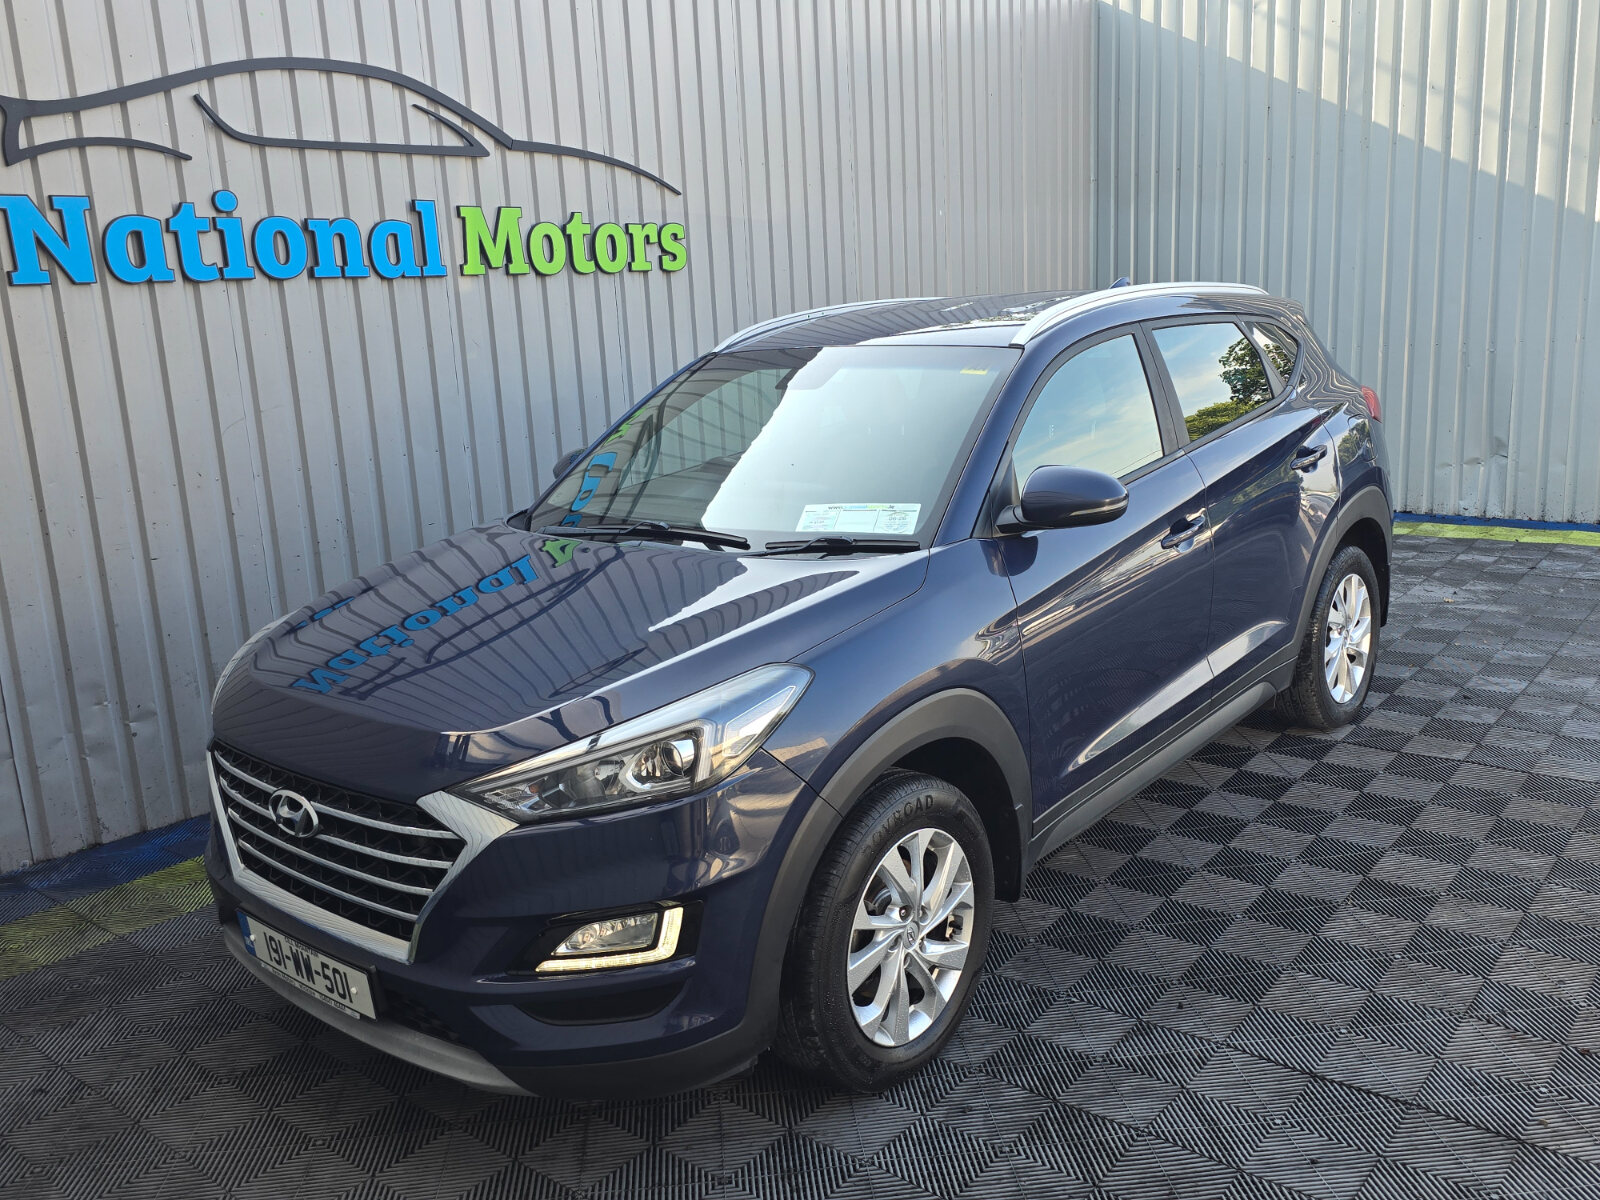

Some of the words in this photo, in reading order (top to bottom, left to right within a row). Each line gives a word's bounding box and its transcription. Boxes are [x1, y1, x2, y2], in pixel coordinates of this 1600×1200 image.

[0, 189, 448, 286] National
[457, 204, 688, 276] Motors
[263, 932, 353, 1003] 191-WW-501
